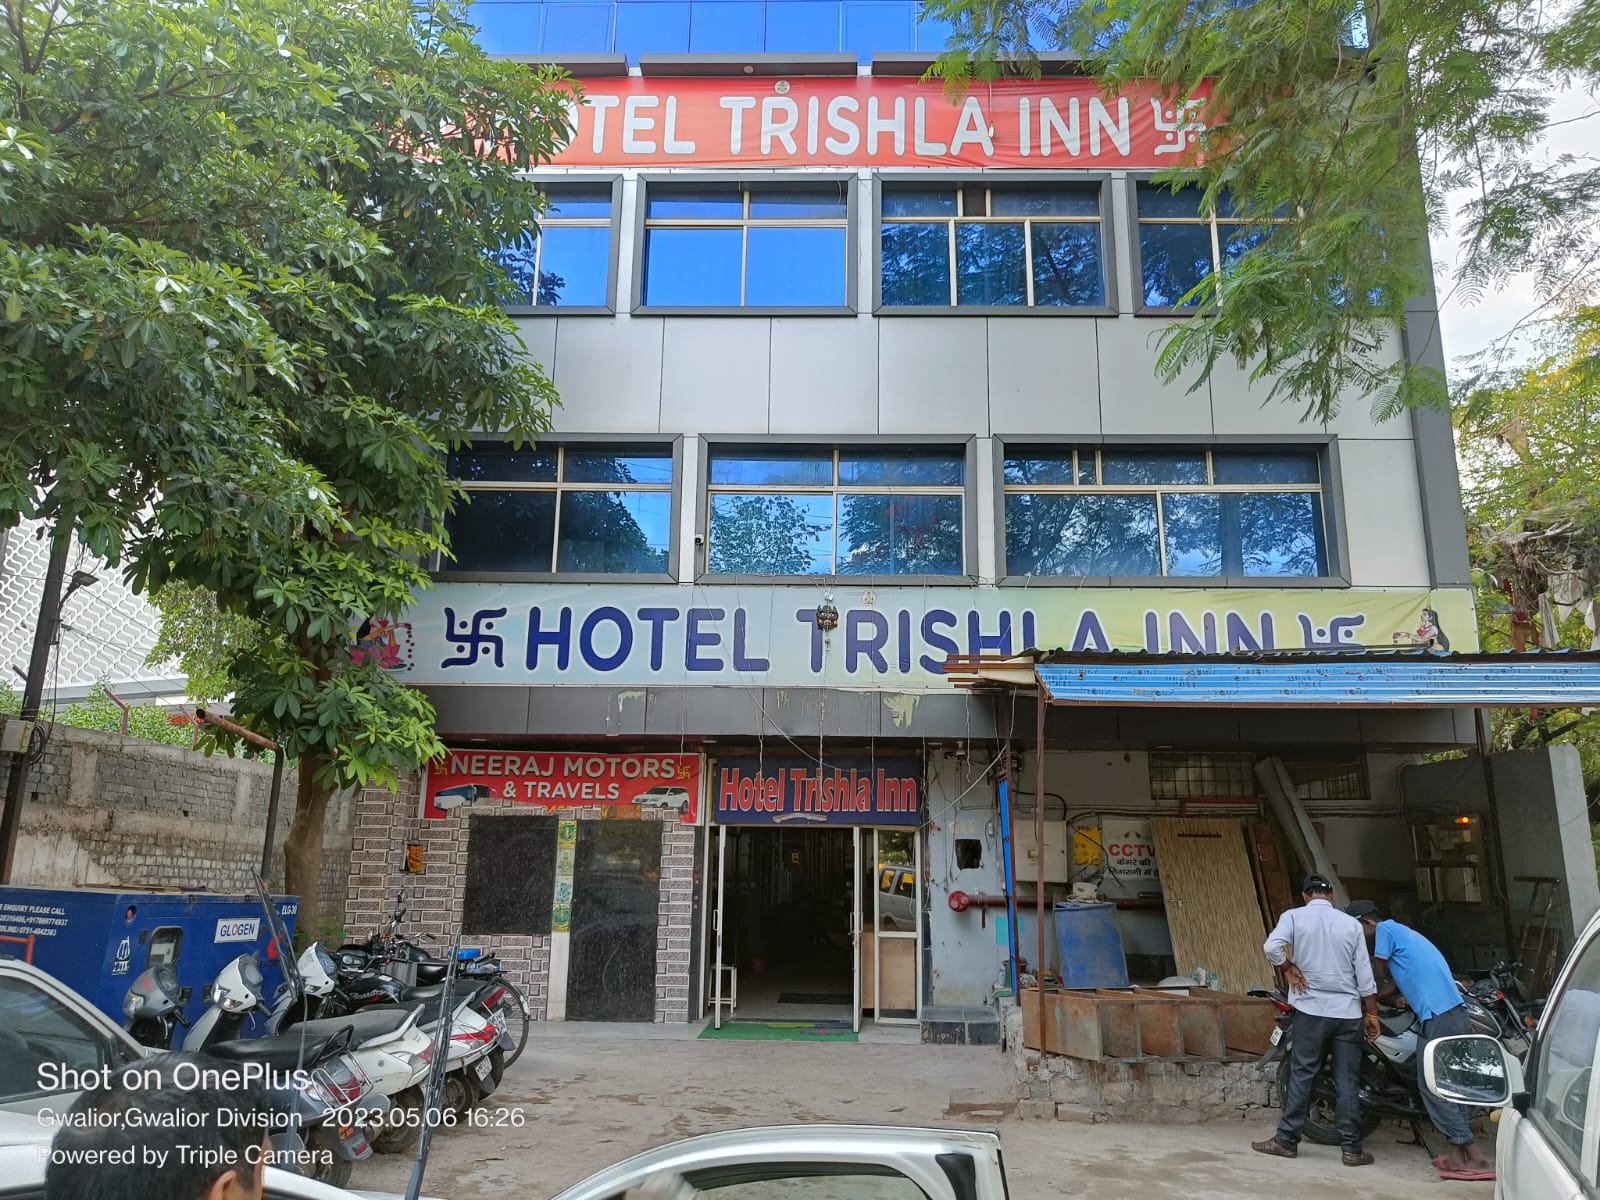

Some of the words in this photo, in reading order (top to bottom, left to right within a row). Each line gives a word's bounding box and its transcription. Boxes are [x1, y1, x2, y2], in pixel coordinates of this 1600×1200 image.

[719, 95, 994, 156] TRISHLA
[1019, 96, 1131, 157] INN
[526, 606, 770, 672] HOTEL
[1145, 611, 1274, 655] INN
[450, 754, 555, 778] NEERAJ
[563, 756, 676, 779] MOTORS
[502, 780, 517, 799] &
[523, 780, 620, 800] TRAVELS
[718, 767, 785, 813] Hotel
[790, 767, 872, 813] Trishla
[876, 767, 917, 813] Inn
[1108, 843, 1155, 857] CCTV
[51, 907, 66, 916] CALL
[220, 923, 255, 937] GLOGEN
